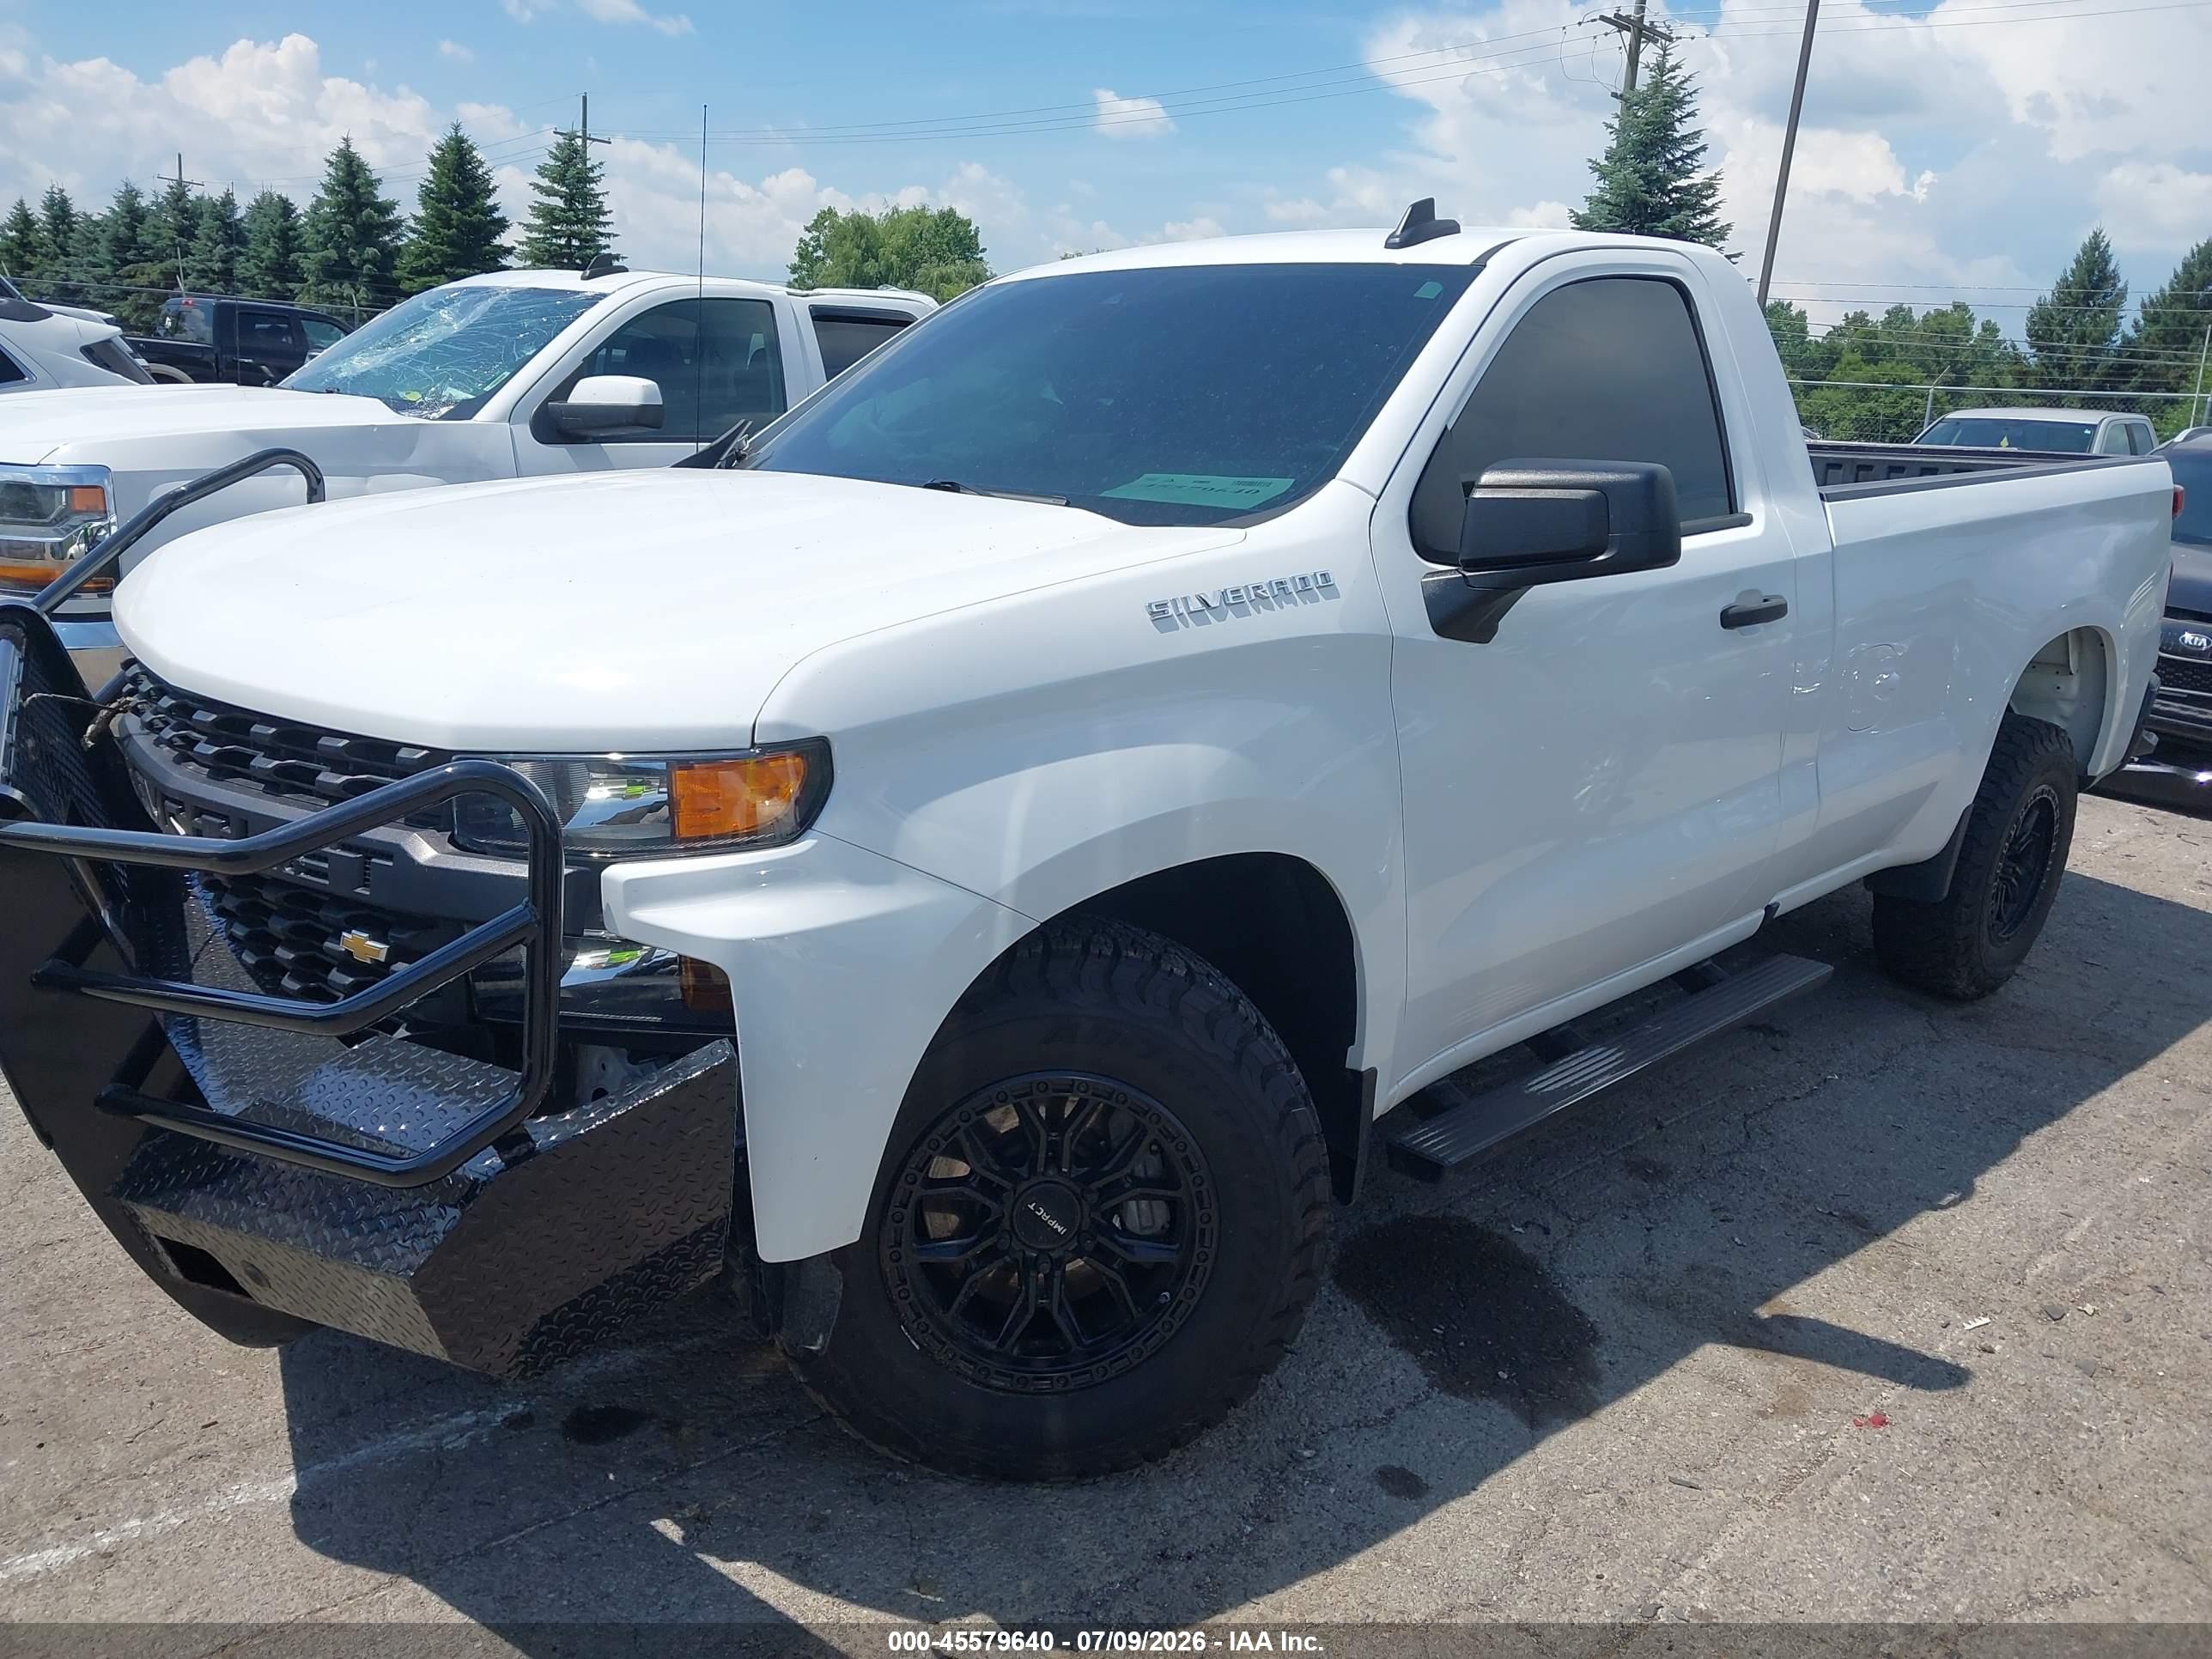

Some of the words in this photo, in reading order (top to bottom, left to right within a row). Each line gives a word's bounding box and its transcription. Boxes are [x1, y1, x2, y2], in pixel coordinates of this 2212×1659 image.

[1146, 570, 1335, 620] SILVERADO
[2184, 634, 2208, 647] KIA
[1027, 1202, 1067, 1235] IMPACT
